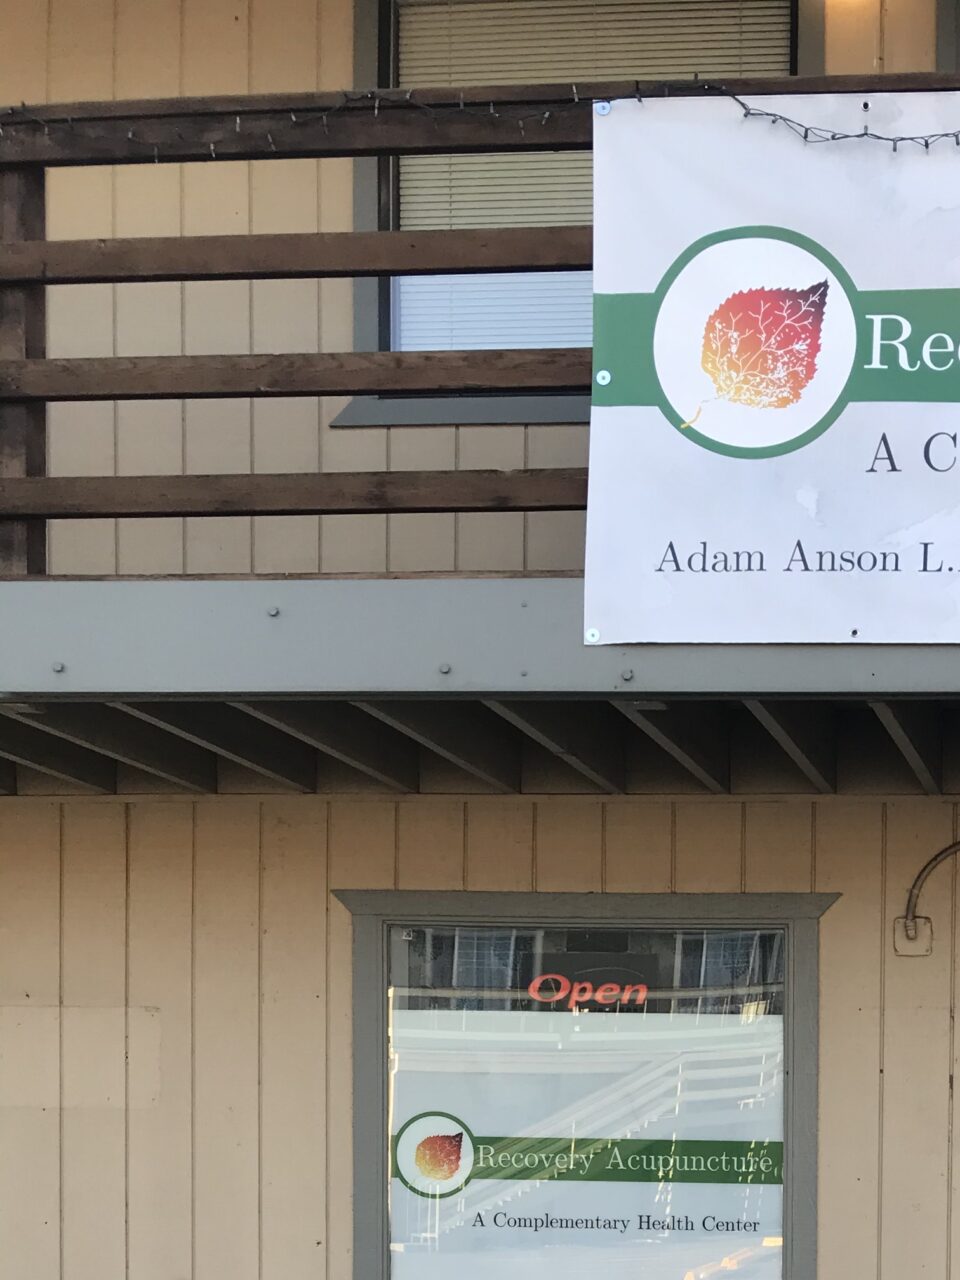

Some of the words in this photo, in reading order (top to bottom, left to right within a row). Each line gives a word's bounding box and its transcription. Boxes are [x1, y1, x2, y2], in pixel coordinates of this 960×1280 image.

[866, 432, 902, 473] A
[655, 541, 766, 573] Adam
[783, 541, 902, 573] Anson
[528, 973, 648, 1009] Open
[476, 1144, 595, 1175] Recovery
[605, 1146, 773, 1179] Acupuncture
[472, 1212, 485, 1227] A
[493, 1212, 630, 1234] Complementary
[638, 1215, 695, 1231] Health
[702, 1216, 760, 1232] Center
